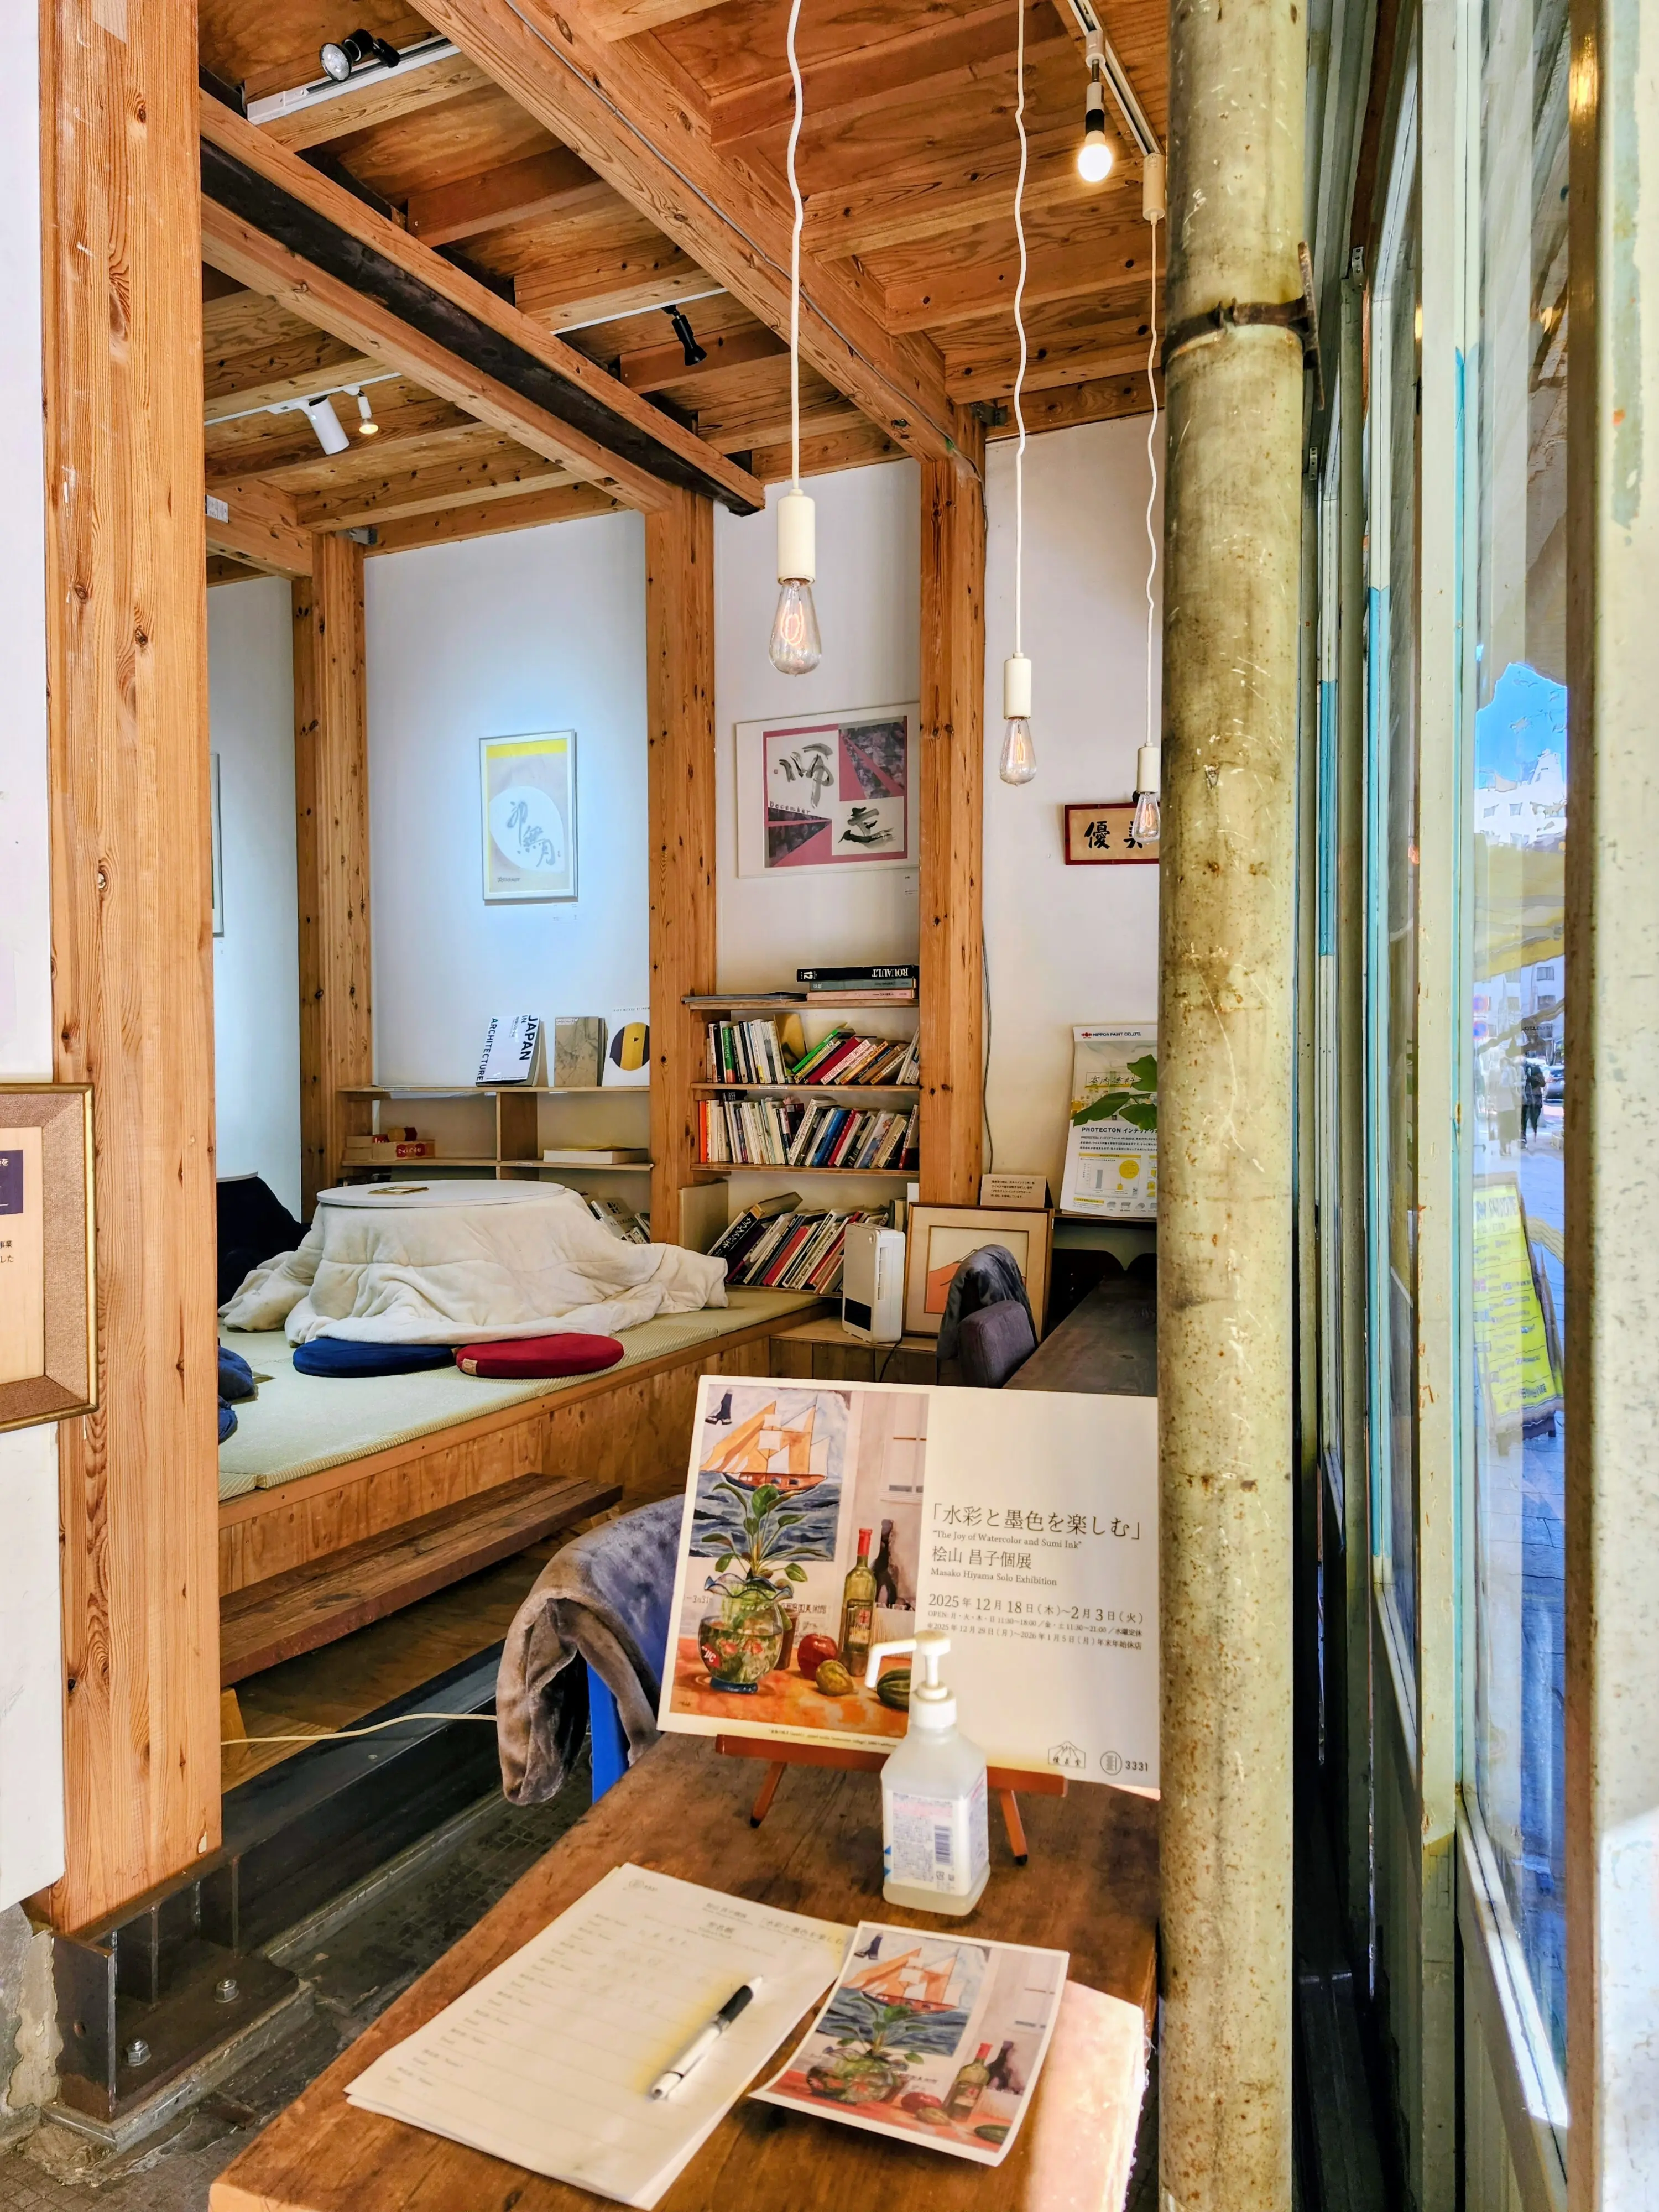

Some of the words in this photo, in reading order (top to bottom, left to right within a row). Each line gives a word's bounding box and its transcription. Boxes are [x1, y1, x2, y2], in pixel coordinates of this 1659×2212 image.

[770, 801, 811, 815] December
[872, 968, 909, 978] ROUAULT
[519, 1015, 538, 1060] JAPAN
[476, 1018, 498, 1081] ARCHITECTURE
[822, 1068, 838, 1083] PROJECT
[933, 1503, 1141, 1540] 「水彩と墨色を楽しむ」
[953, 1532, 966, 1542] Joy
[978, 1534, 1022, 1545] Watercolor
[1024, 1537, 1039, 1546] and
[1041, 1539, 1063, 1548] Sumi
[932, 1546, 962, 1563] 桧山
[968, 1549, 1032, 1569] 昌子個展
[931, 1567, 961, 1578] Masako
[963, 1570, 994, 1581] Hiyama
[996, 1572, 1013, 1582] Solo
[1015, 1574, 1057, 1586] Exhibition
[1125, 1760, 1148, 1772] 3331
